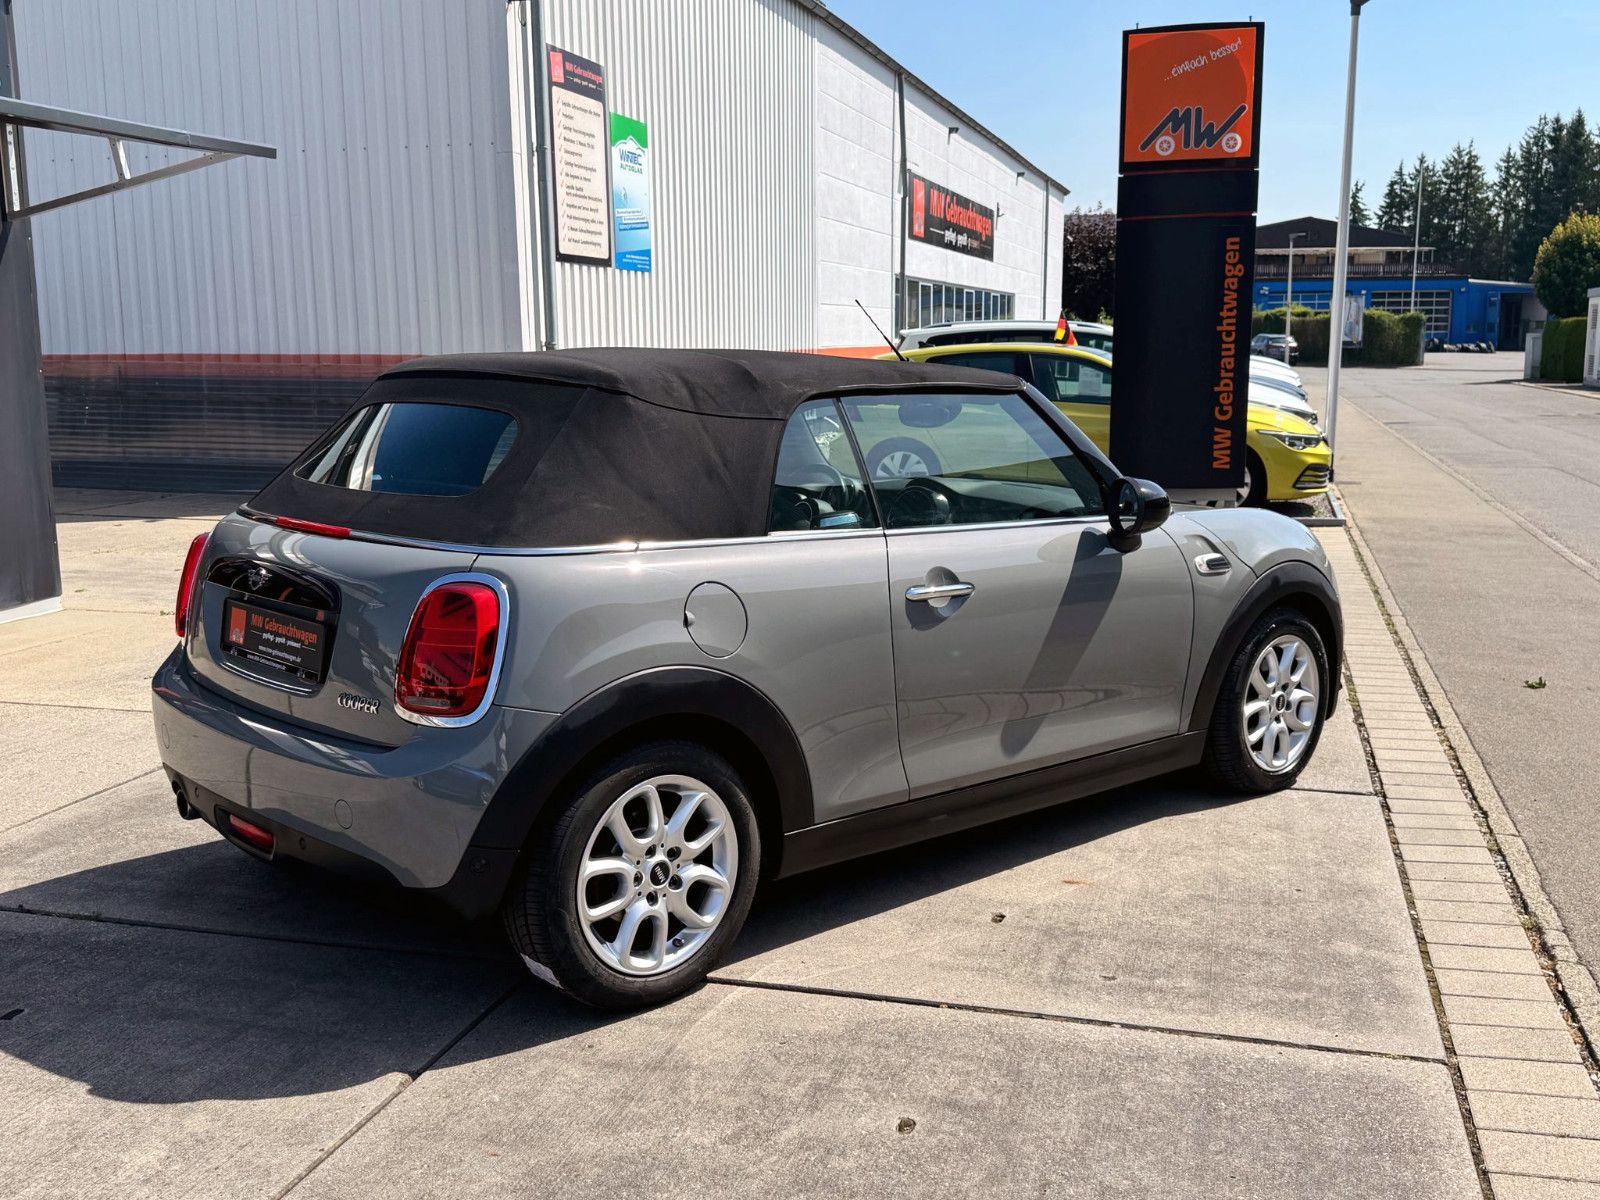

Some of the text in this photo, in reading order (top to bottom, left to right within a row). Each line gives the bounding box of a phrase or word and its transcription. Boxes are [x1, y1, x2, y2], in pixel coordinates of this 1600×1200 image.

[1138, 103, 1248, 152] MW
[930, 188, 945, 219] MW
[945, 195, 992, 241] Gebrauchtwagen
[1212, 236, 1245, 469] MW Gebrauchtwagen
[251, 613, 264, 629] MW
[264, 617, 317, 645] Gebrauchtwagen
[337, 692, 380, 715] COOPER
[654, 865, 666, 883] MINI
